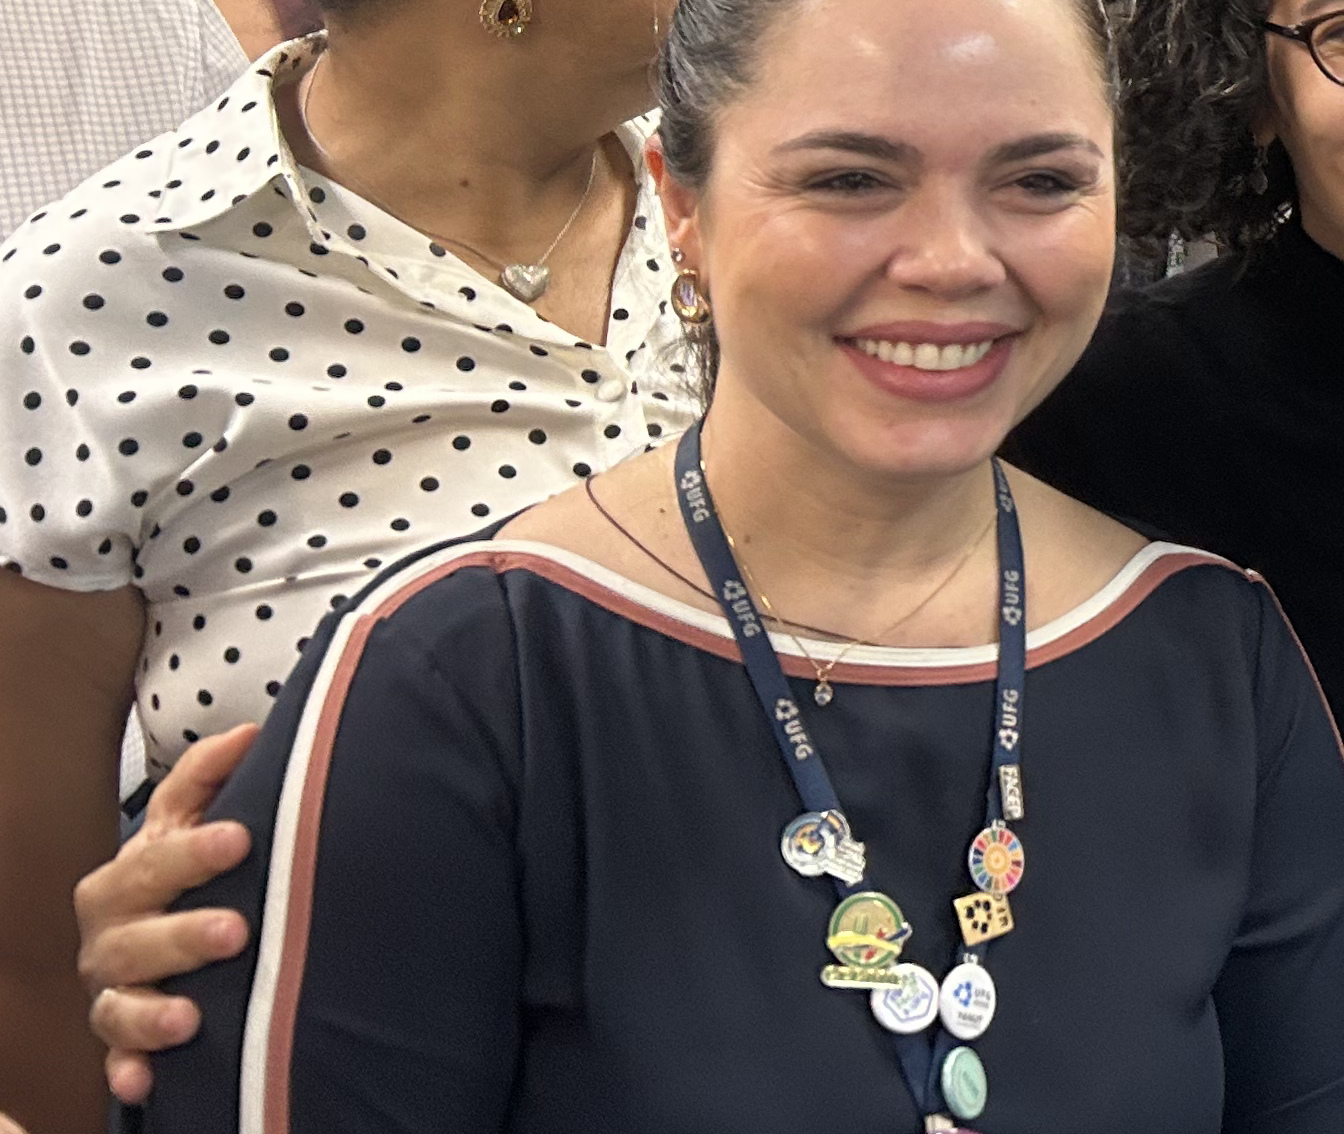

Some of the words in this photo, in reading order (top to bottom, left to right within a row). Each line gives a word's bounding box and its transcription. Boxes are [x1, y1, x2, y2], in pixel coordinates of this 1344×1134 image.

[1005, 570, 1020, 604] UFG
[732, 600, 761, 638] UFG
[1002, 689, 1019, 727] UFG
[784, 721, 814, 761] UFG
